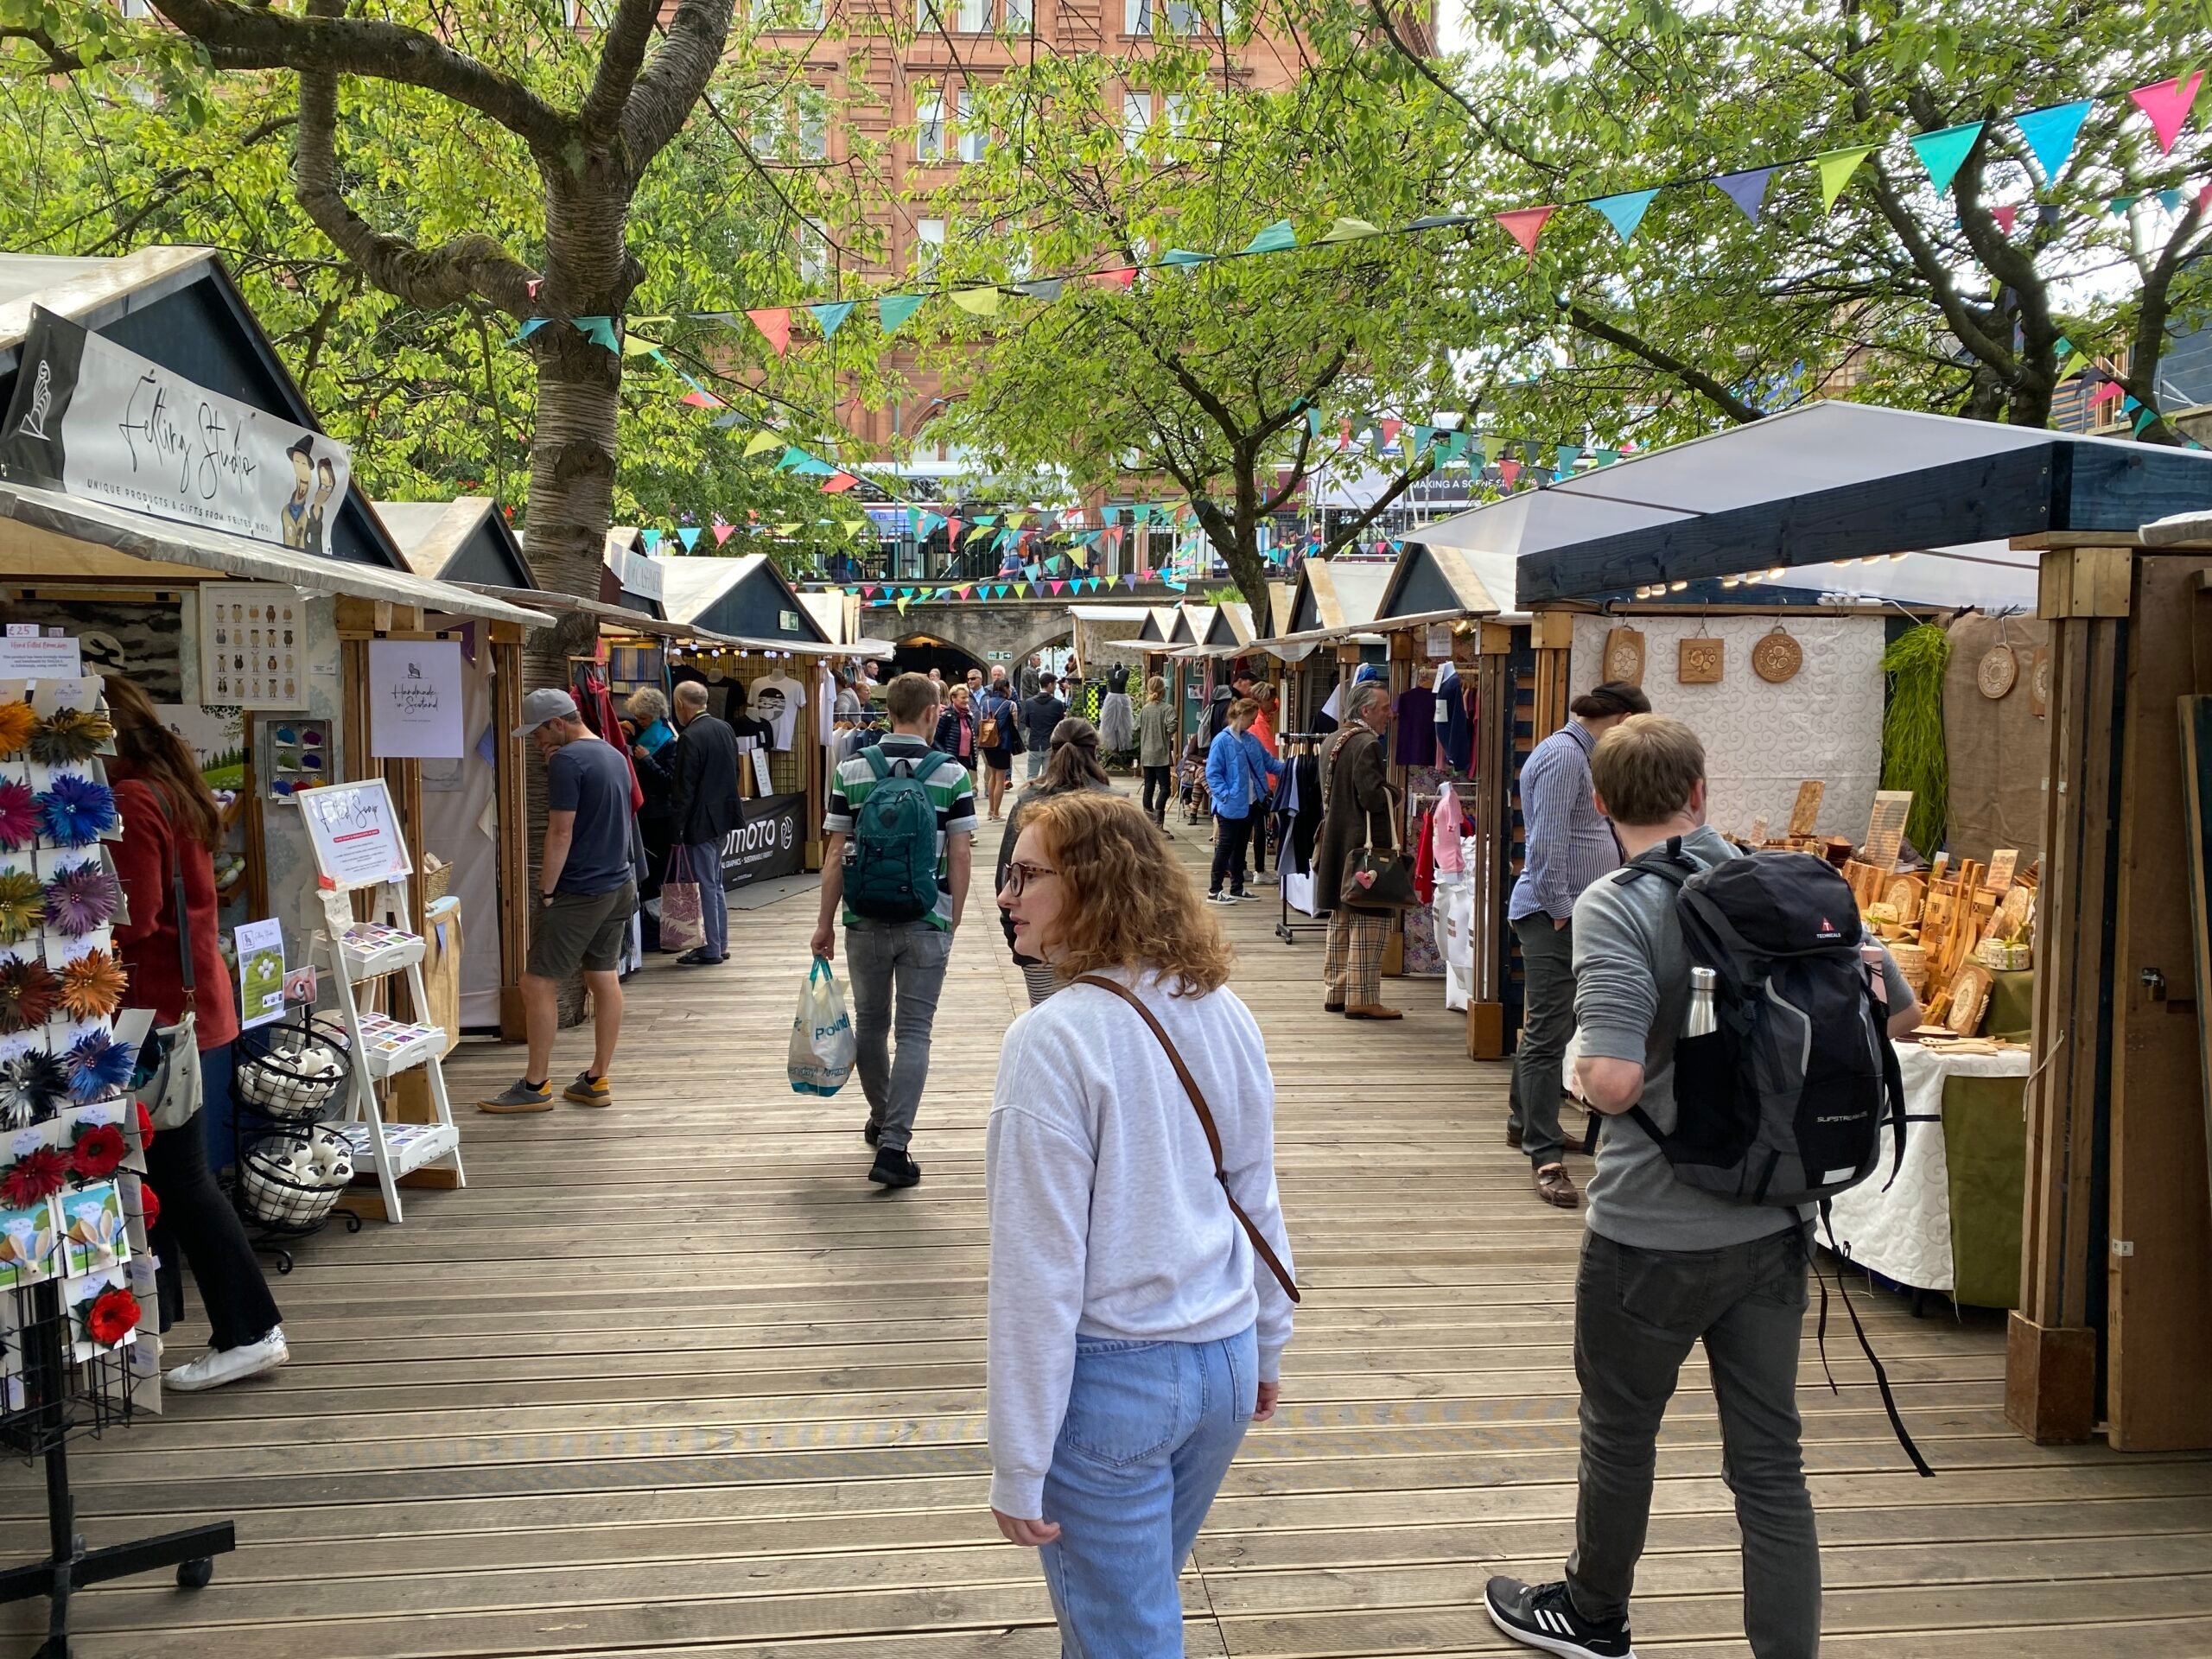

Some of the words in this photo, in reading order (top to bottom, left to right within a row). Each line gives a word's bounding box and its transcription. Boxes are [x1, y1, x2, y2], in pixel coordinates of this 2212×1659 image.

[119, 375, 191, 493] Felting
[199, 402, 256, 499] Studio
[1412, 480, 1450, 489] MAKING
[1452, 480, 1459, 489] A
[87, 478, 121, 495] UNIQUE
[125, 488, 168, 507] PRODUCTS
[180, 503, 203, 517] GIFTS
[206, 510, 224, 521] FROM
[228, 515, 251, 528] FELTED
[256, 522, 272, 533] WOOL
[8, 625, 31, 636] £25
[391, 683, 437, 700] Handmade
